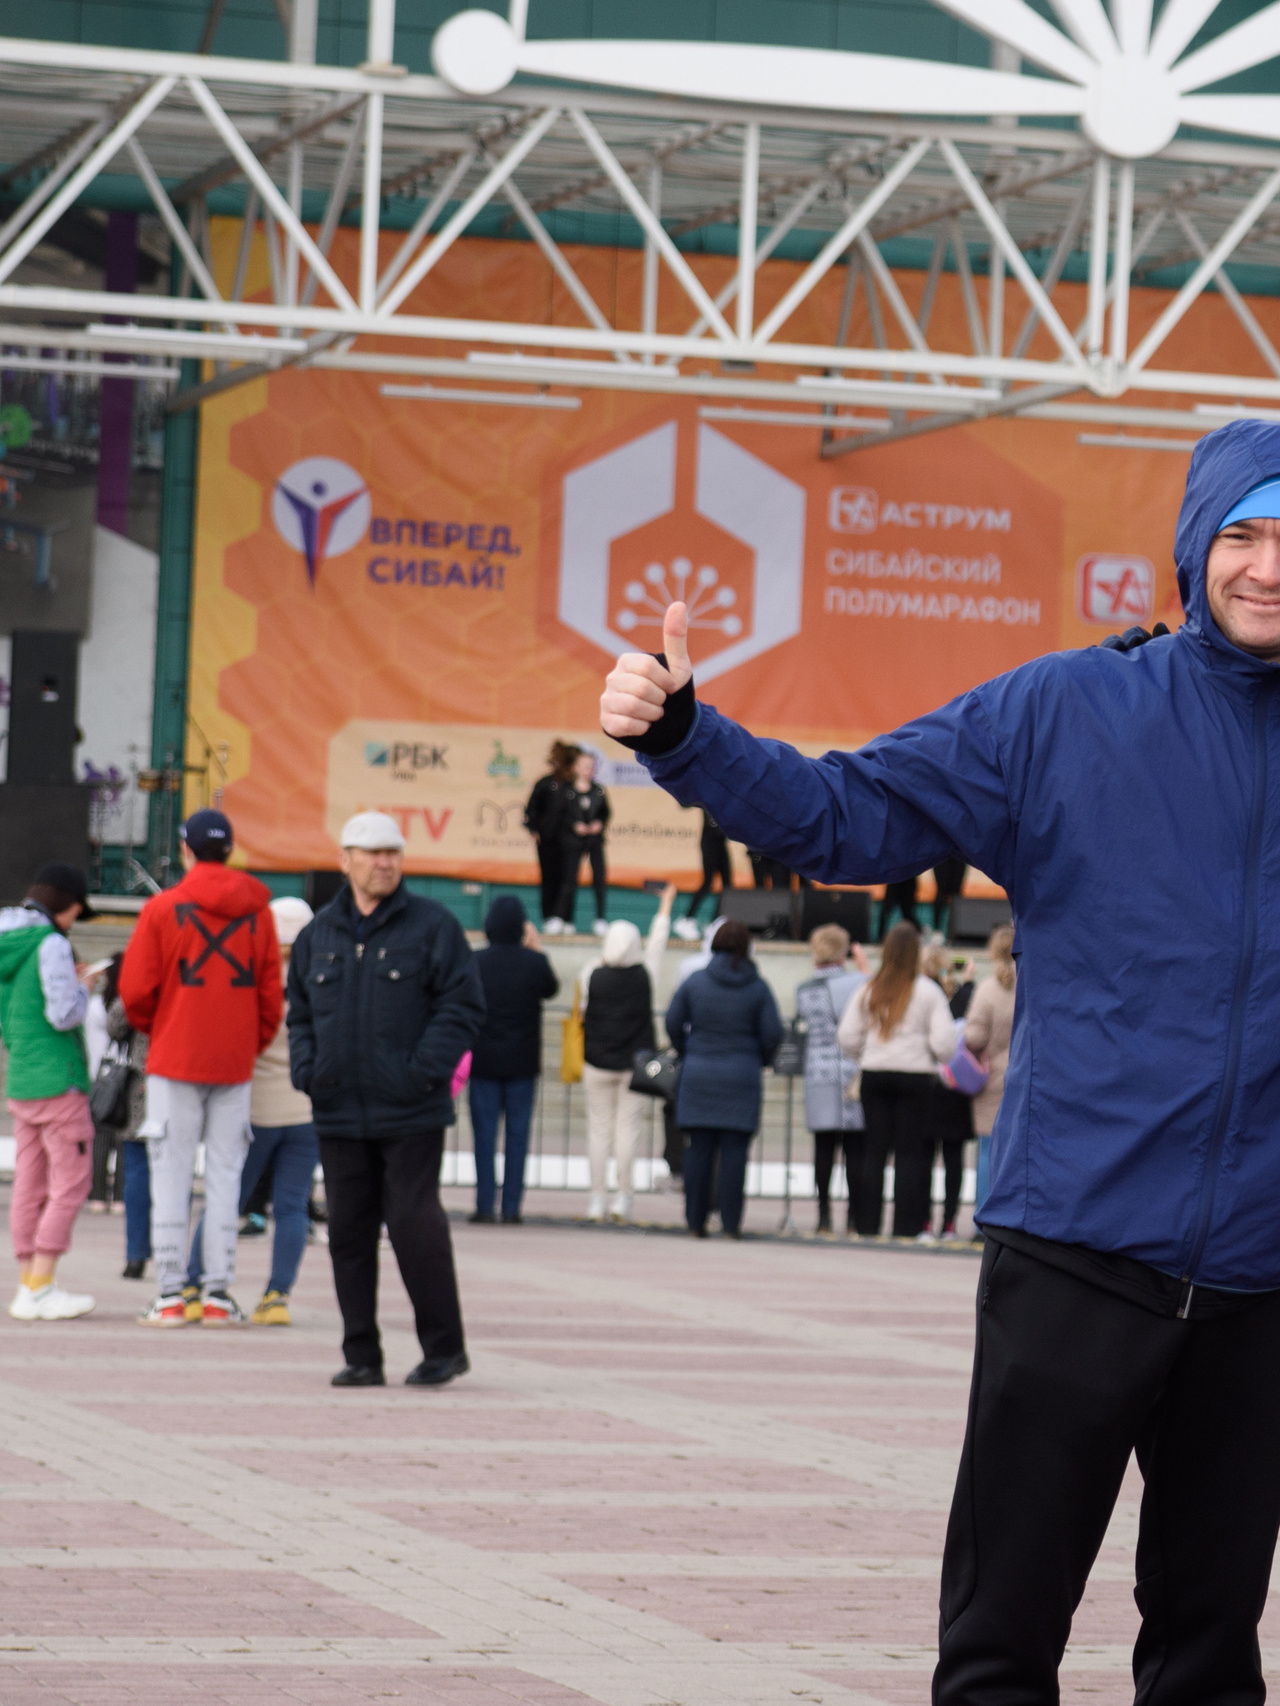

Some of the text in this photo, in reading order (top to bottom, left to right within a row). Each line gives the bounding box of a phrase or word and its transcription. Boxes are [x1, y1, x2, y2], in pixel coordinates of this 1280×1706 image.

[880, 501, 1011, 532] АСТРУМ
[370, 517, 522, 557] ВПЕРЕД,
[367, 556, 504, 591] СИБАЙ!
[826, 548, 1002, 586] СИБАЙСКИЙ
[824, 585, 1041, 626] ПОЛУМАРАФОН
[392, 740, 449, 770] РБК
